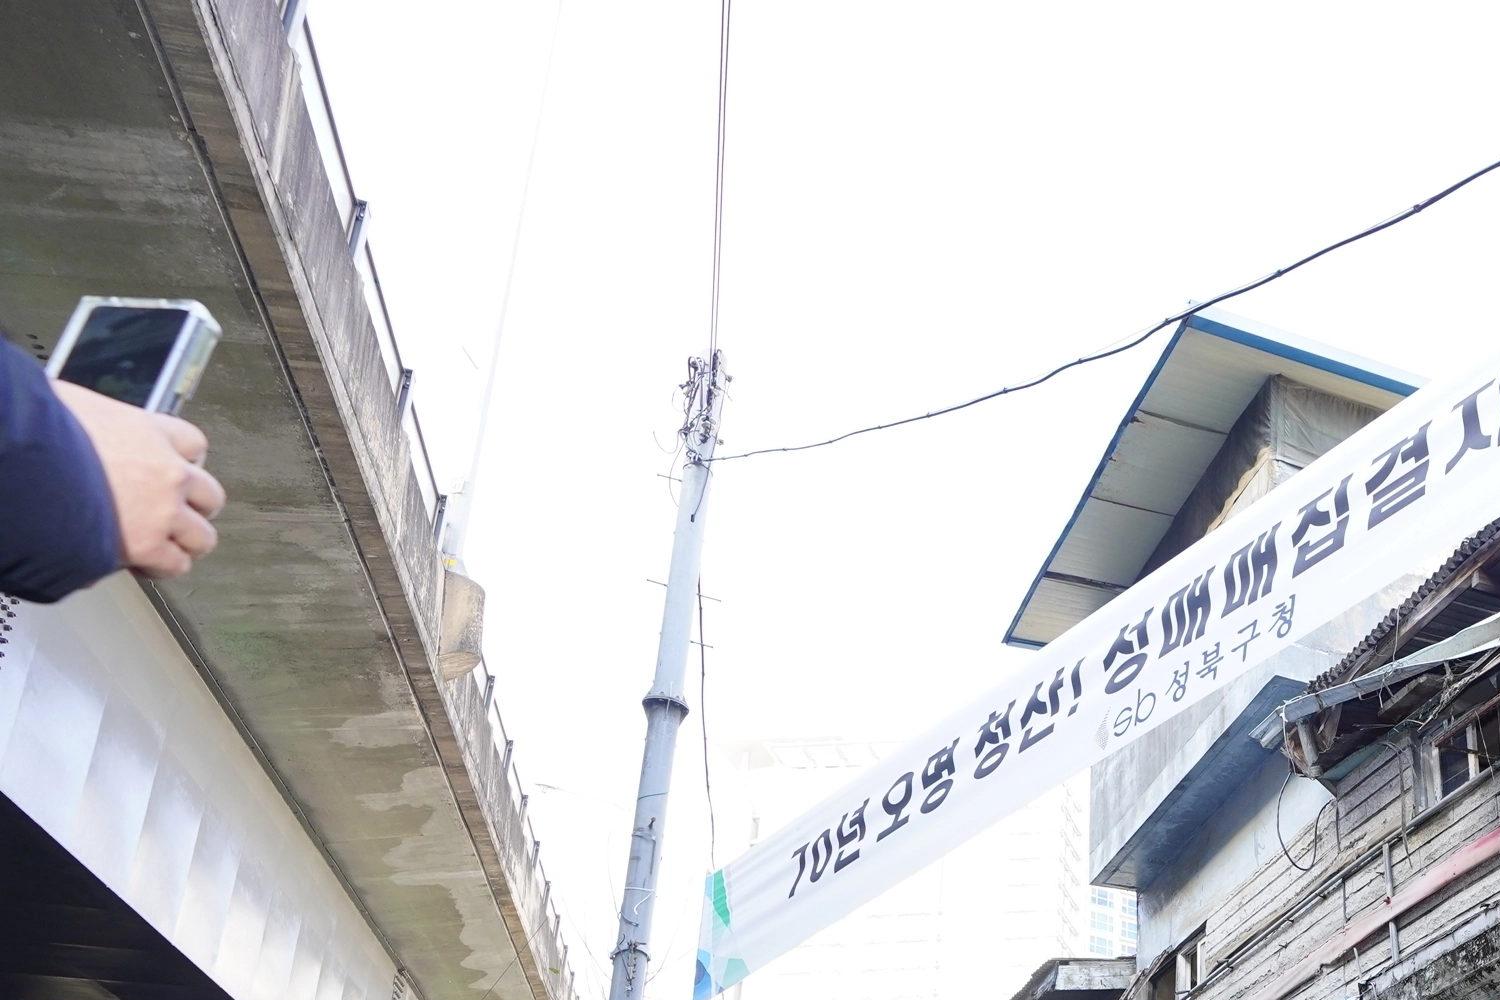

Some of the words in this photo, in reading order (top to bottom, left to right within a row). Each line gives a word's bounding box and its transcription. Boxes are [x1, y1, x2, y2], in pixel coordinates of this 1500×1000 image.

[1165, 594, 1298, 703] 성북구청
[788, 798, 870, 900] 70년
[876, 736, 961, 843] 오명
[973, 656, 1086, 781] 청산!
